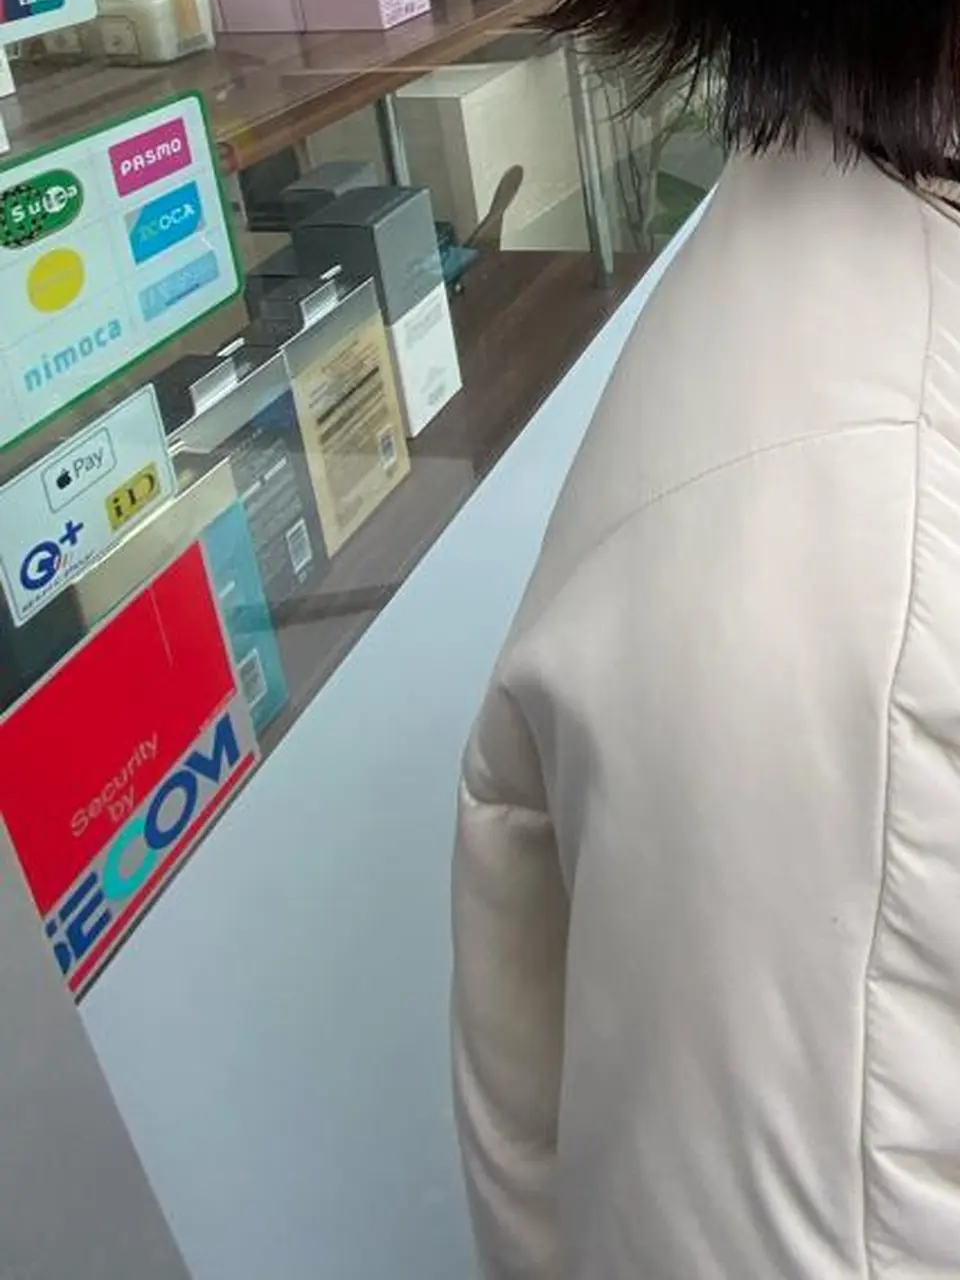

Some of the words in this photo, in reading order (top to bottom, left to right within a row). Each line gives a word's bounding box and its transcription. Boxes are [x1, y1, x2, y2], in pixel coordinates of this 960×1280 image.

[120, 137, 182, 176] PASMO
[23, 320, 122, 391] nimoca
[72, 447, 105, 479] Pay
[70, 731, 159, 838] Security
[106, 785, 136, 825] by
